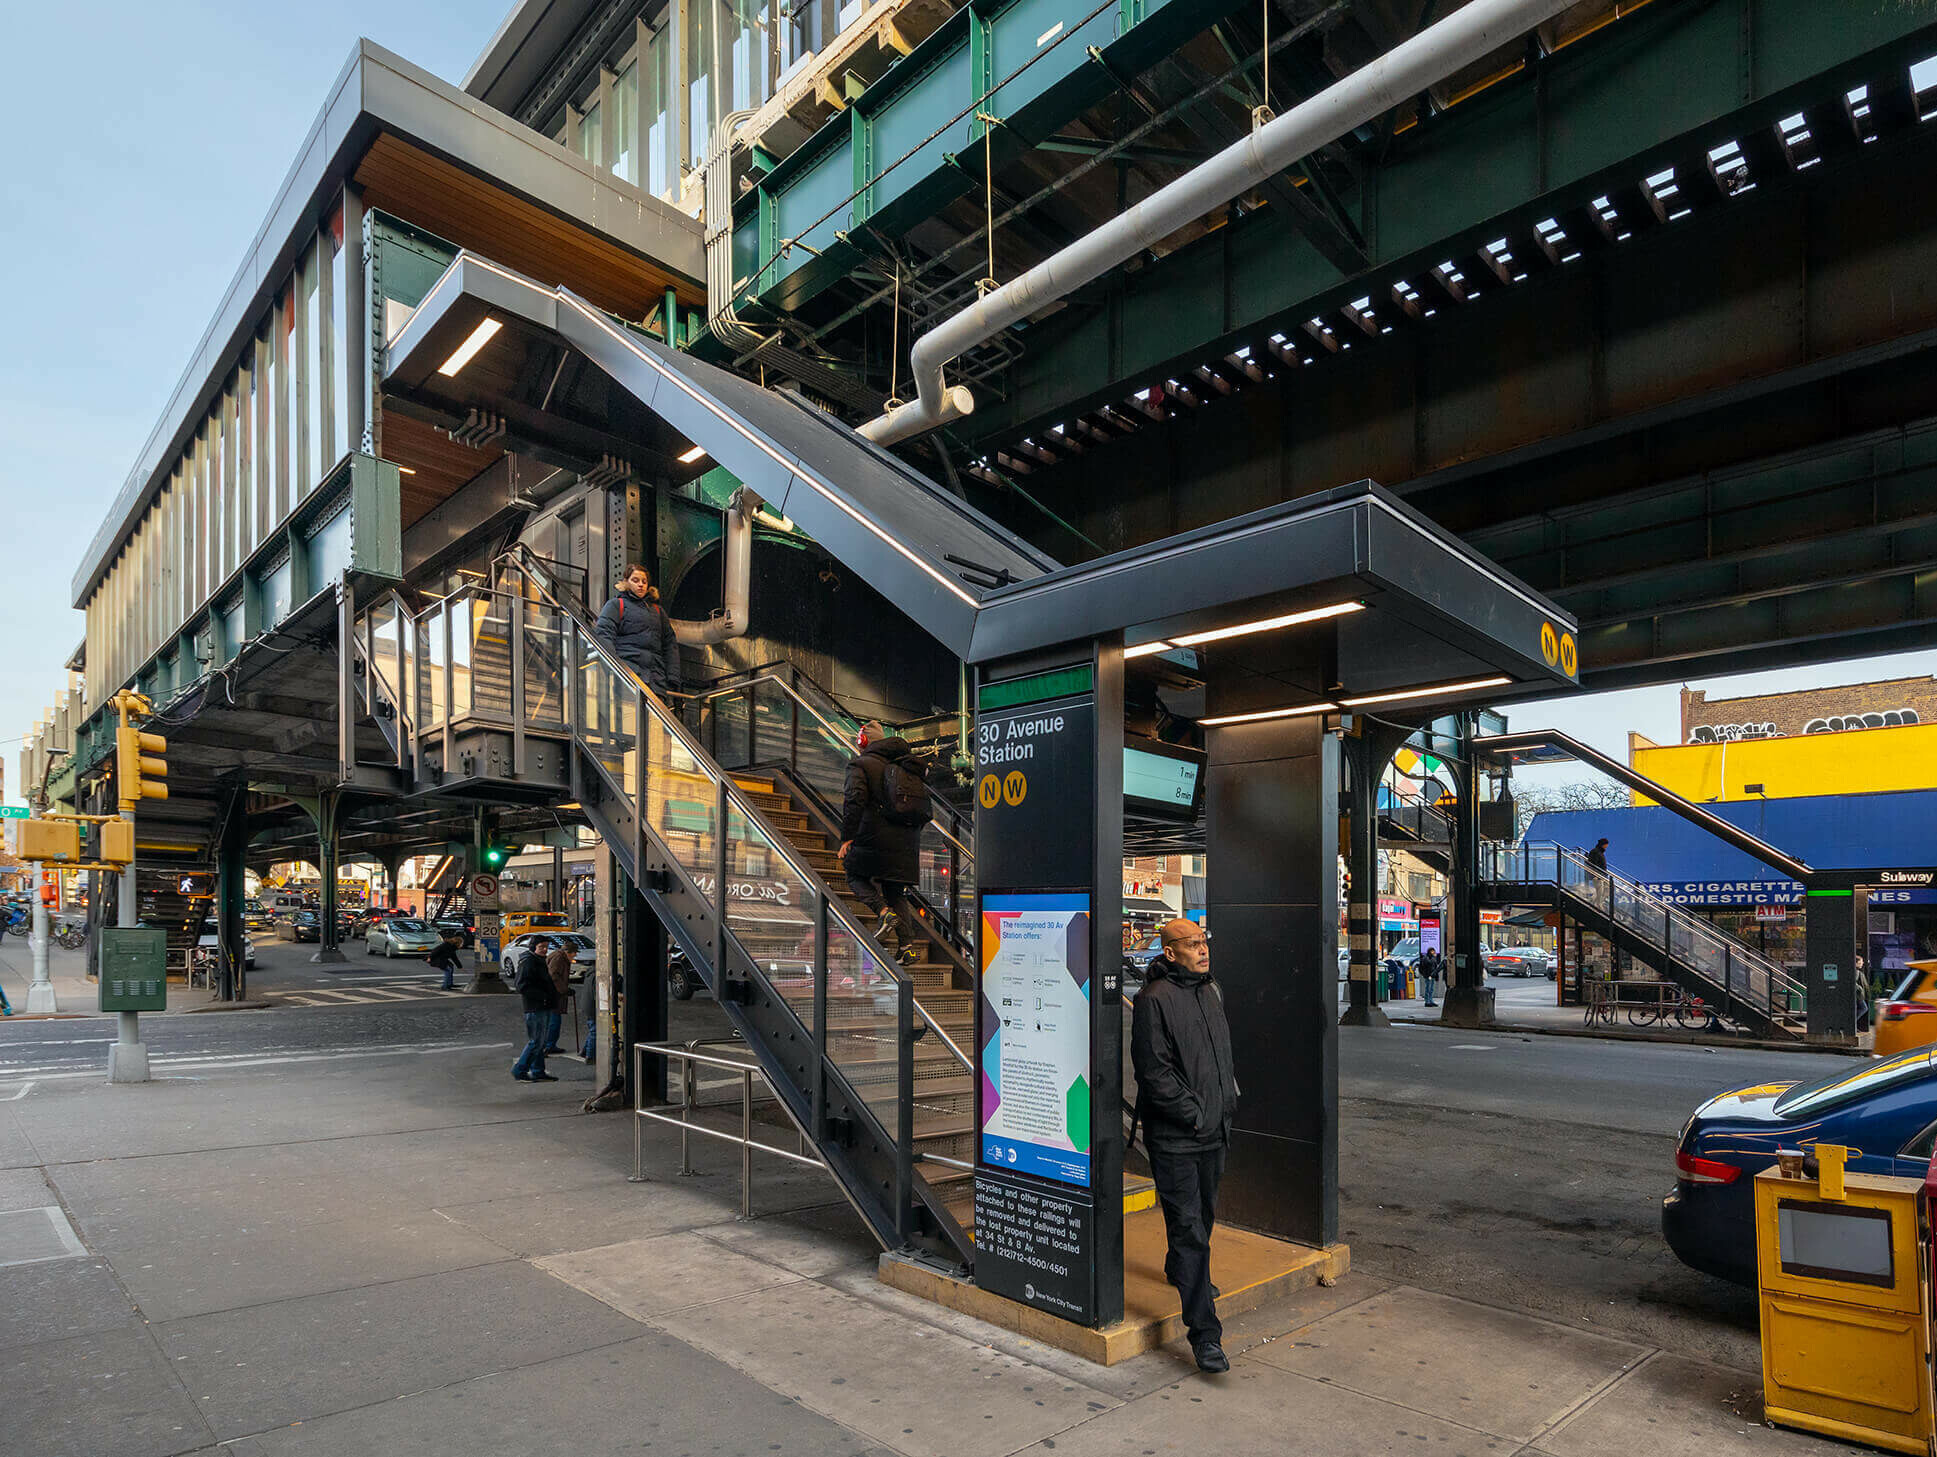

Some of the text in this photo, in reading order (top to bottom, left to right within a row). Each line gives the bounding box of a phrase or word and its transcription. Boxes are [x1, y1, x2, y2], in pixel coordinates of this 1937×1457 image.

[980, 716, 1065, 744] 30 Avenue
[979, 742, 1034, 766] Station
[1180, 766, 1195, 779] 1 min
[1007, 778, 1024, 800] W
[1176, 787, 1192, 800] 8 min
[1880, 872, 1934, 884] Subway
[1662, 894, 1770, 904] DOMESTIC
[1757, 905, 1785, 916] ATM
[482, 927, 498, 936] 20
[1003, 921, 1013, 929] The
[1014, 921, 1046, 931] reimagined
[1024, 932, 1042, 940] offers:
[975, 1180, 1073, 1215] Bicycles and other property
[975, 1193, 1081, 1229] attached to these railings will
[975, 1204, 1078, 1241] be removed and delivered to
[975, 1216, 1080, 1255] the lost property unit located
[975, 1229, 983, 1238] at
[985, 1231, 994, 1241] 34
[997, 1234, 1005, 1245] St
[1007, 1237, 1013, 1247] &
[1024, 1243, 1036, 1254] Av.
[1046, 1295, 1056, 1304] York
[1056, 1299, 1066, 1308] City
